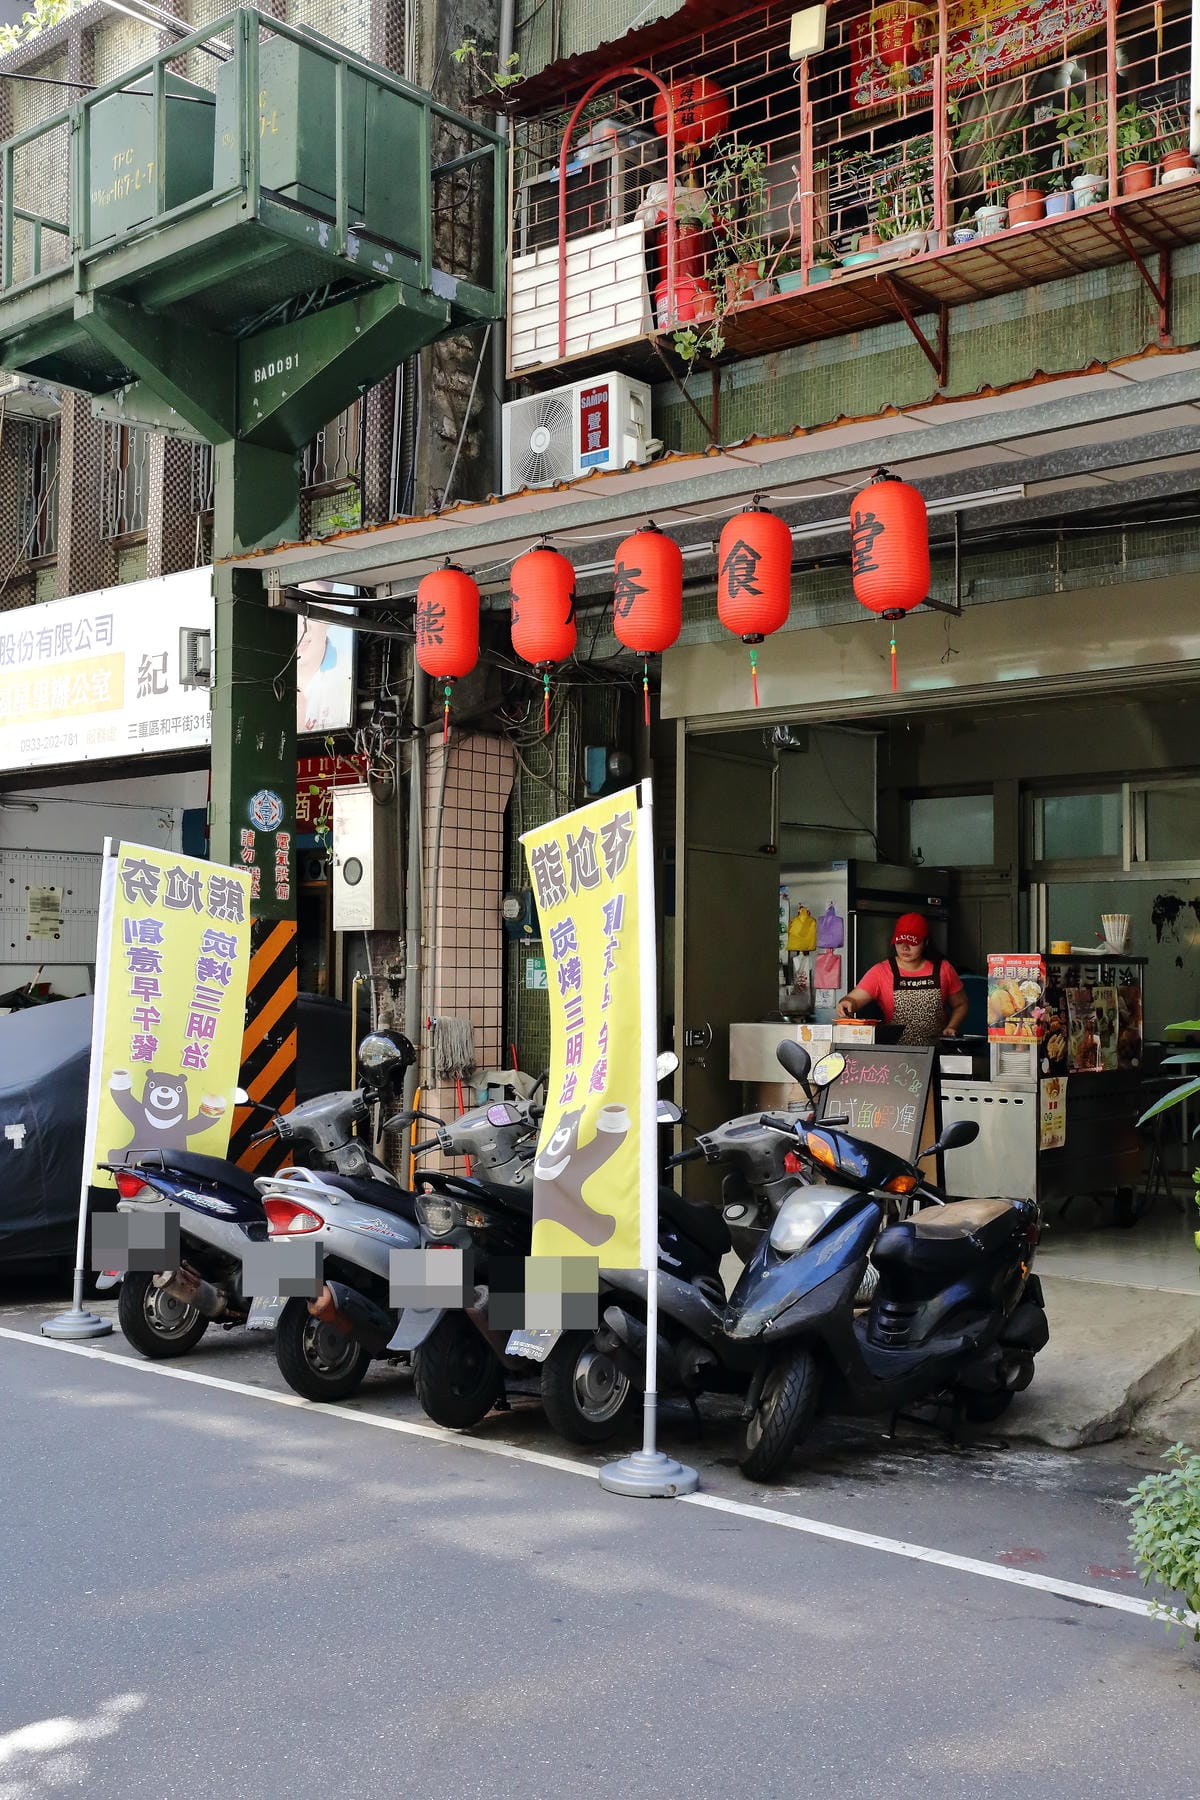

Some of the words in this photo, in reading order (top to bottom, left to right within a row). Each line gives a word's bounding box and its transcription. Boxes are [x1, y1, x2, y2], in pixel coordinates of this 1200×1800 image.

[254, 352, 299, 384] BA0091
[581, 391, 608, 408] SAMPO
[720, 539, 764, 598] 食
[850, 511, 885, 577] 堂
[0, 614, 113, 666] 股份有限公司
[20, 733, 78, 752] 0933-202-781
[274, 833, 290, 900] 電氣設備
[531, 810, 632, 909] 熊尬夯
[550, 917, 584, 1104] 炭烤三明治
